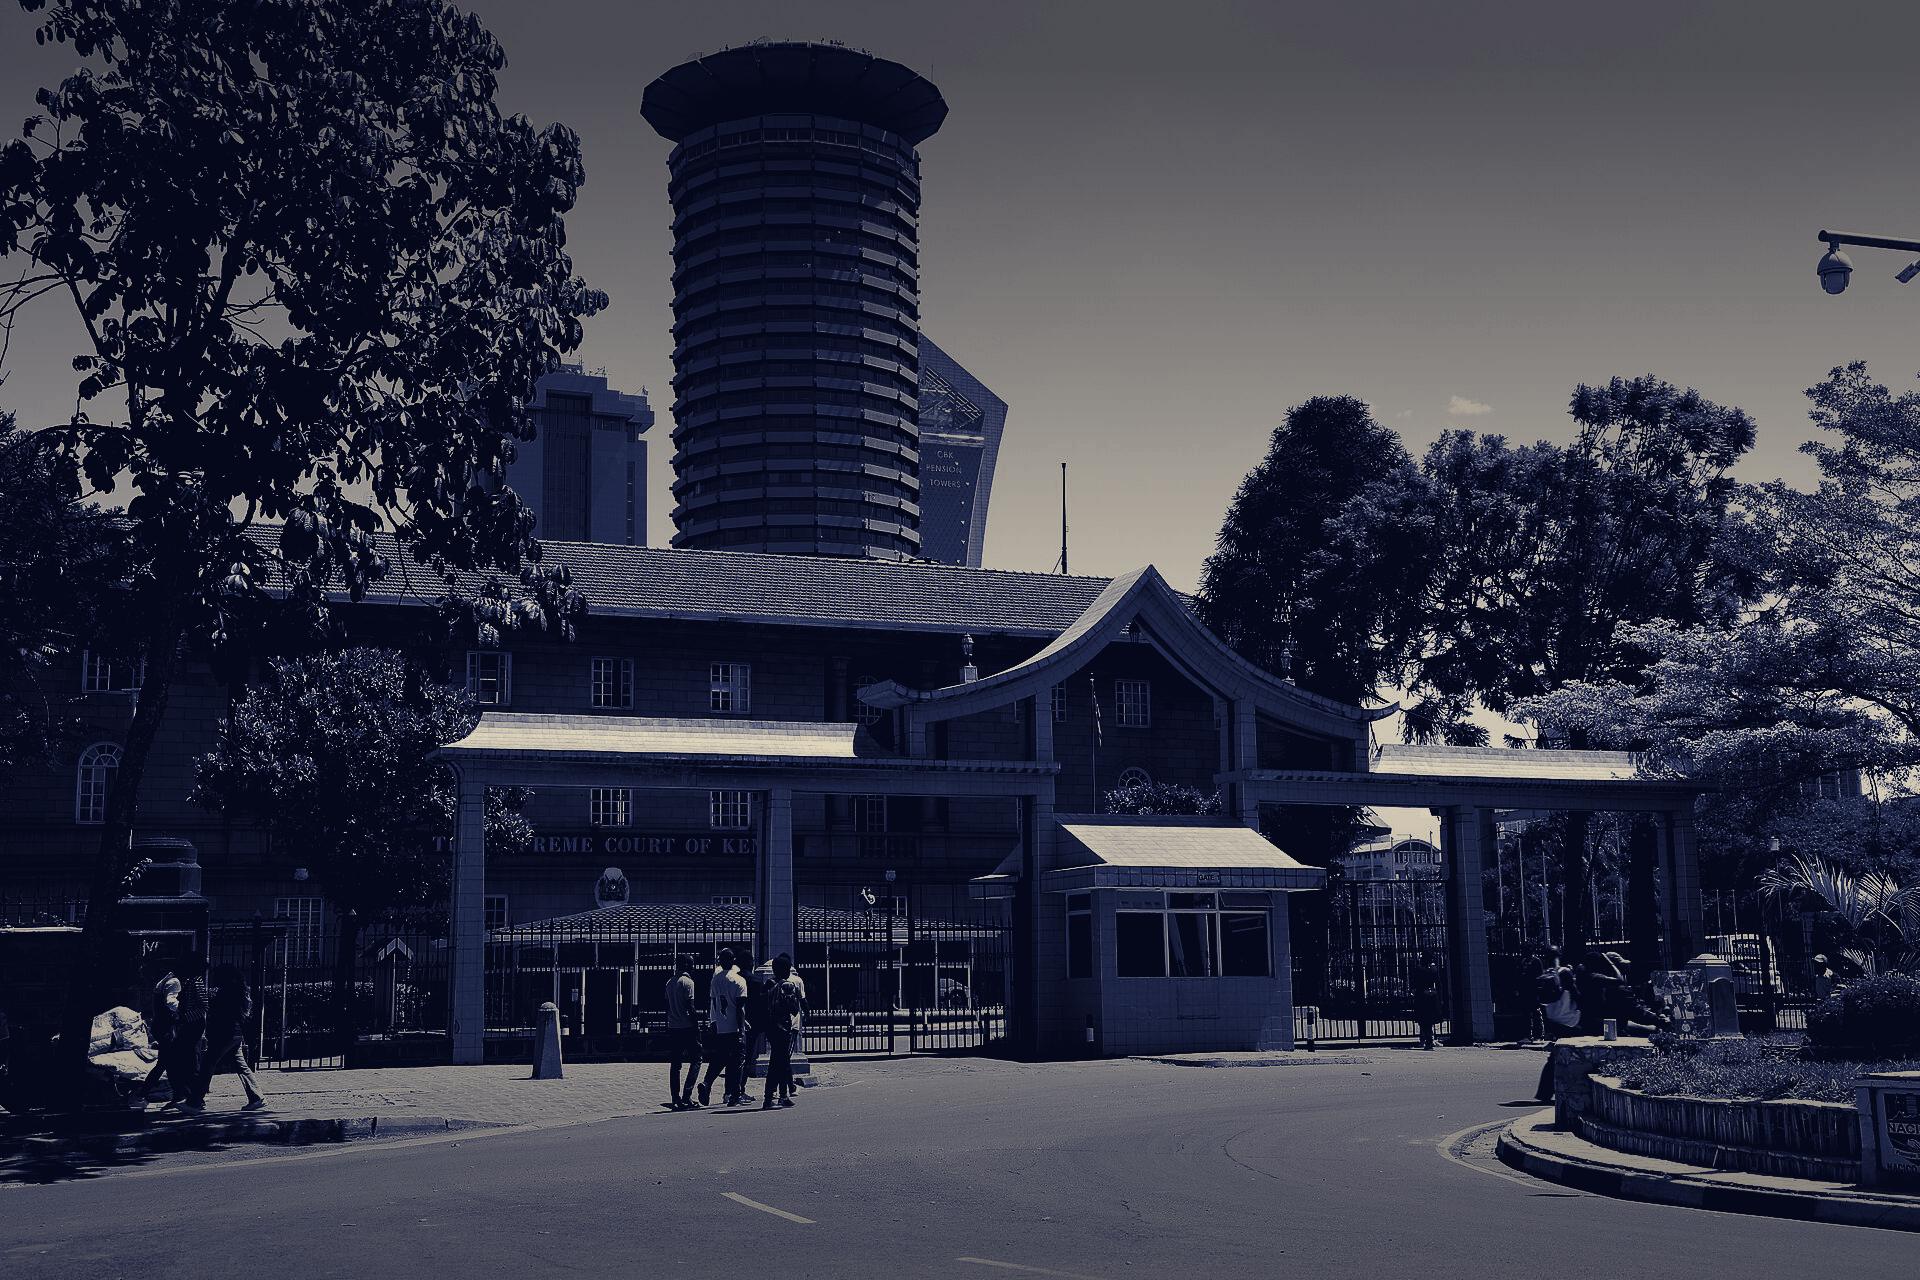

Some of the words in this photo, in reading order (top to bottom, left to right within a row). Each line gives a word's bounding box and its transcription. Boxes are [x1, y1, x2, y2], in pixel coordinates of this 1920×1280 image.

[937, 450, 954, 459] CBK
[926, 464, 962, 474] PENSION
[930, 479, 961, 488] TOWERS
[522, 836, 593, 853] REME
[604, 837, 676, 854] COURT
[685, 838, 711, 854] OF
[1198, 873, 1215, 881] GATE
[1887, 1122, 1920, 1135] NACI
